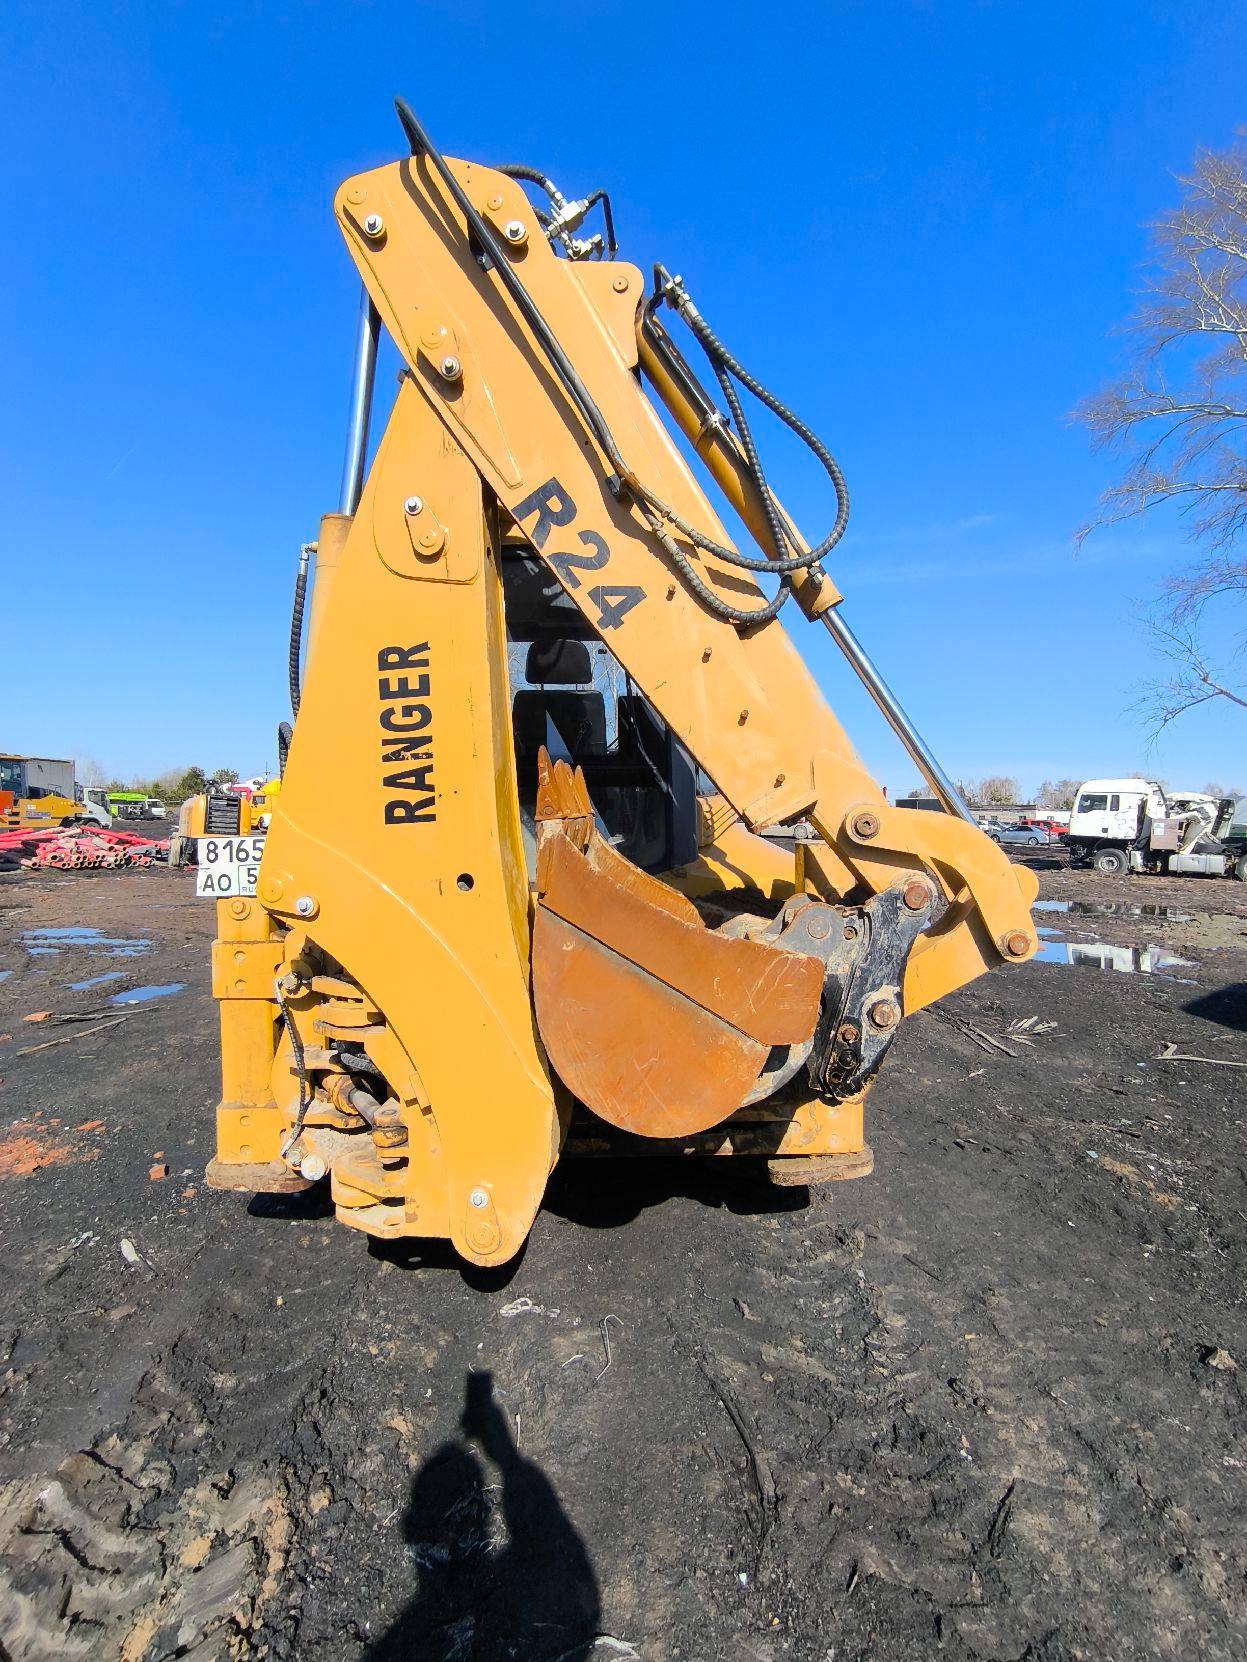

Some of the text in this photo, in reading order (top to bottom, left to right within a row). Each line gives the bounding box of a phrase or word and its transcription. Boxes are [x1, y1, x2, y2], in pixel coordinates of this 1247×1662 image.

[511, 476, 648, 631] R24
[378, 641, 437, 825] RANGER
[206, 839, 265, 864] 8165
